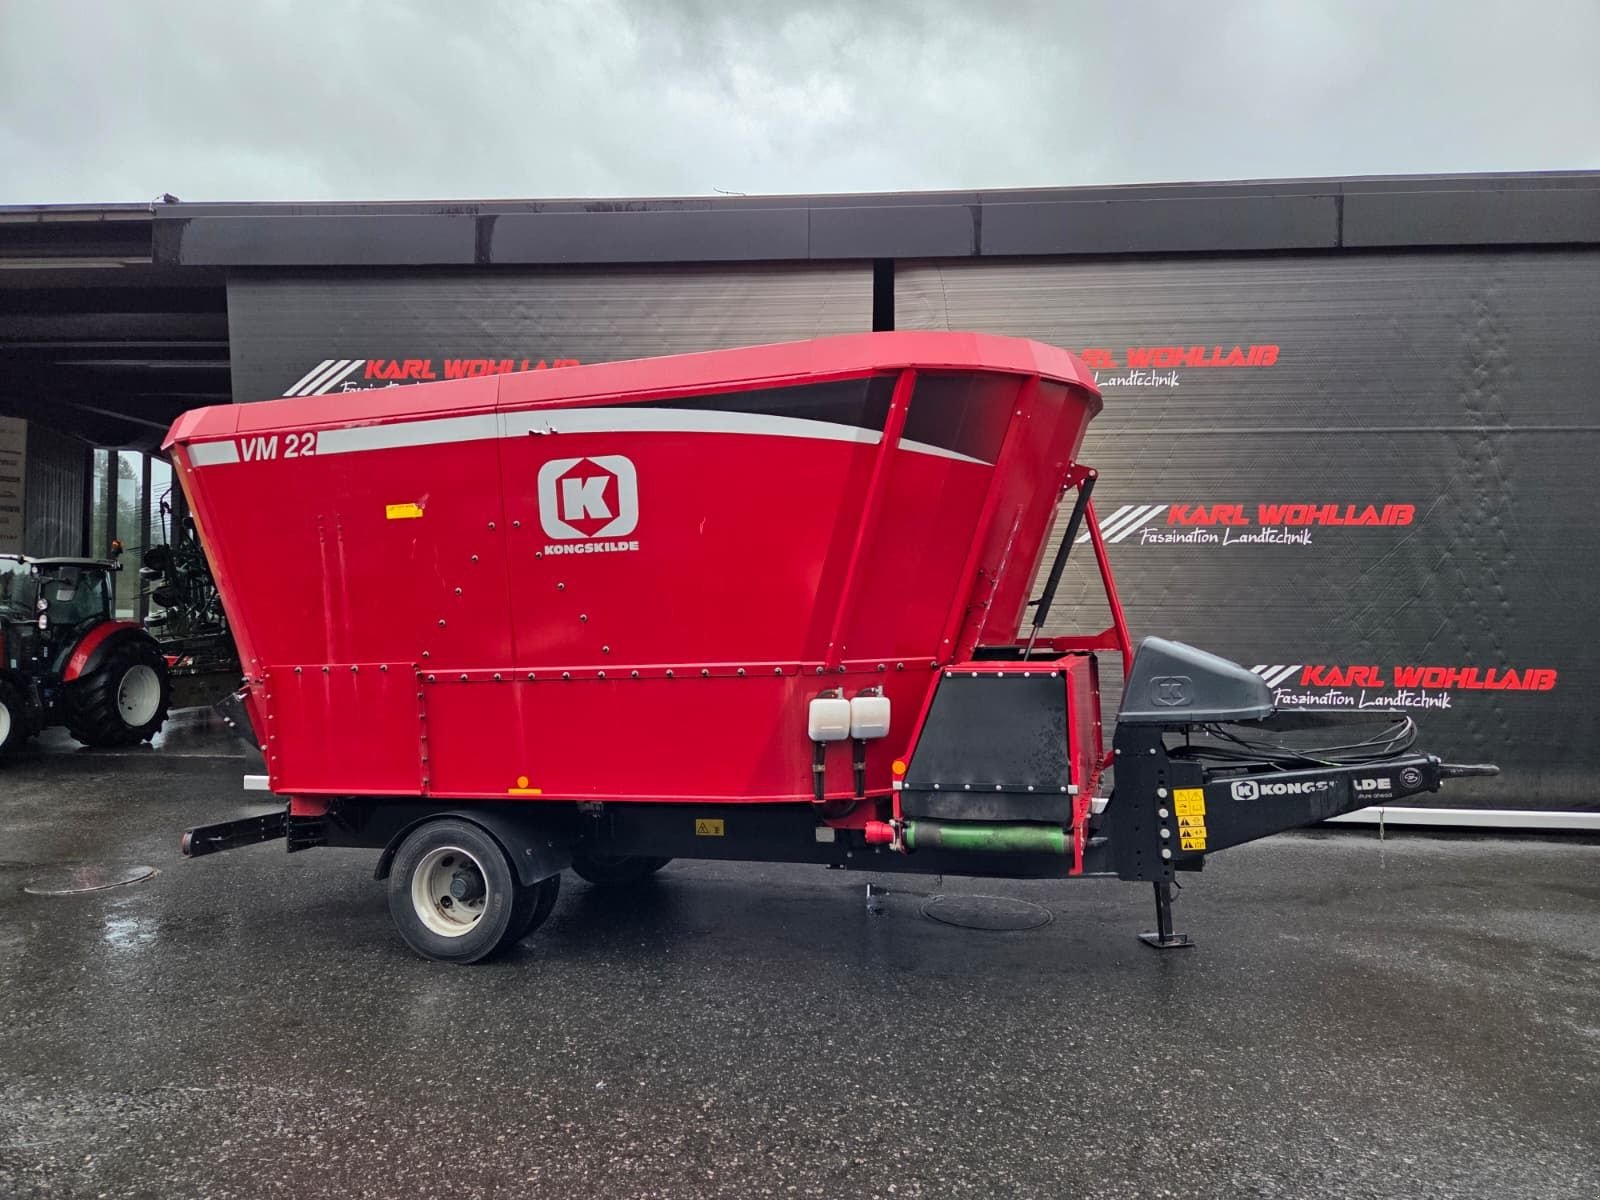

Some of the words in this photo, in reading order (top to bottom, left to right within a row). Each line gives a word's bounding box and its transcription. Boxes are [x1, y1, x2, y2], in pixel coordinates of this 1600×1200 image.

[1127, 345, 1280, 368] WOHLLAIB
[364, 359, 436, 379] KARL
[1094, 369, 1180, 387] Landtechnik
[241, 435, 278, 462] VM
[283, 432, 316, 458] 22
[1167, 504, 1250, 525] KARL
[1258, 504, 1416, 526] WOHLLAIB
[1139, 527, 1218, 545] Faszination
[1222, 527, 1313, 546] Landtechnik
[543, 541, 639, 555] KONGSKILDE
[1300, 665, 1384, 687] KARL
[1393, 666, 1557, 691] WOHLLAIB
[1273, 688, 1354, 706] Faszination
[1358, 689, 1452, 708] Landtechnik
